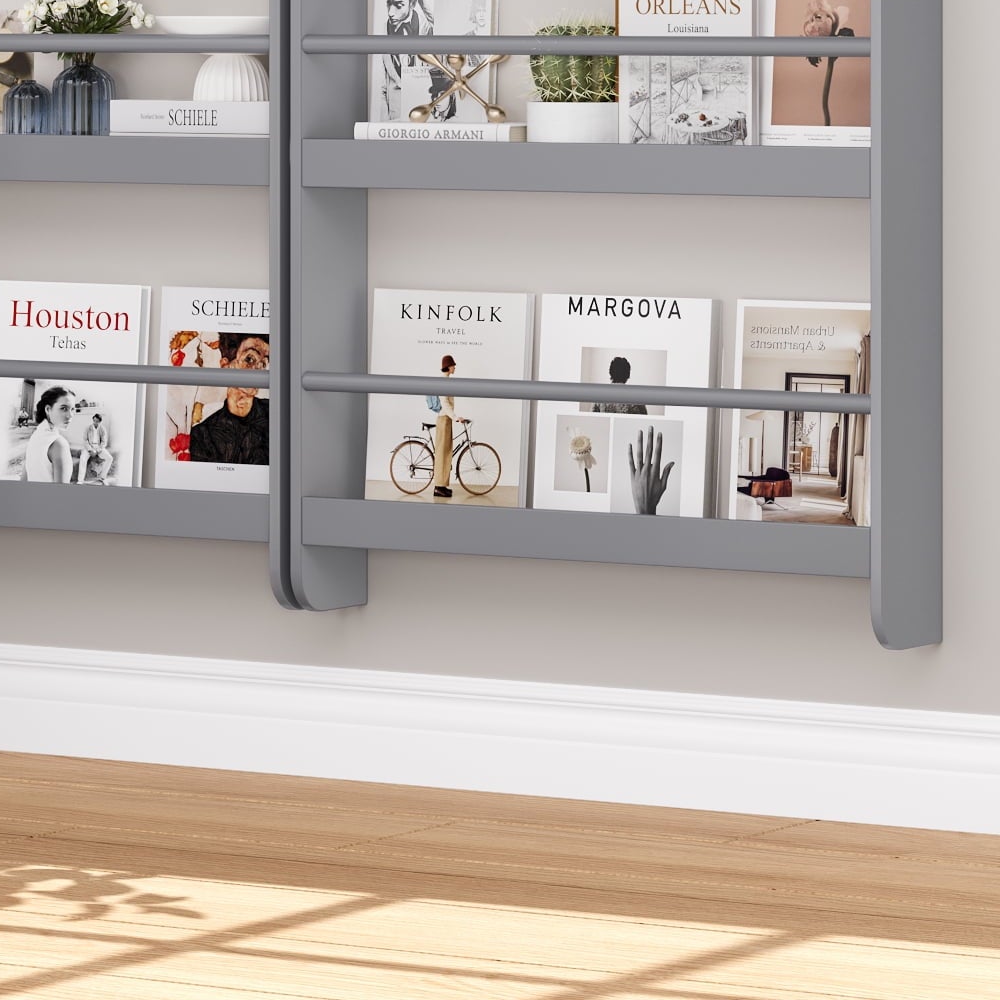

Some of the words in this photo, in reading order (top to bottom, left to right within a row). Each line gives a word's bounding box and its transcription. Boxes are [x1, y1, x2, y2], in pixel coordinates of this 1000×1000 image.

[667, 23, 709, 33] Louisiana
[168, 108, 218, 126] SCHIELE
[378, 128, 430, 139] GIORGIO
[434, 129, 484, 140] ARMANI
[8, 299, 131, 332] Houston
[191, 299, 270, 318] SCHIELE
[400, 303, 503, 323] KINFOLK
[568, 296, 682, 320] MARGOVA
[436, 327, 467, 336] TRAVEL
[49, 335, 87, 350] Tehas
